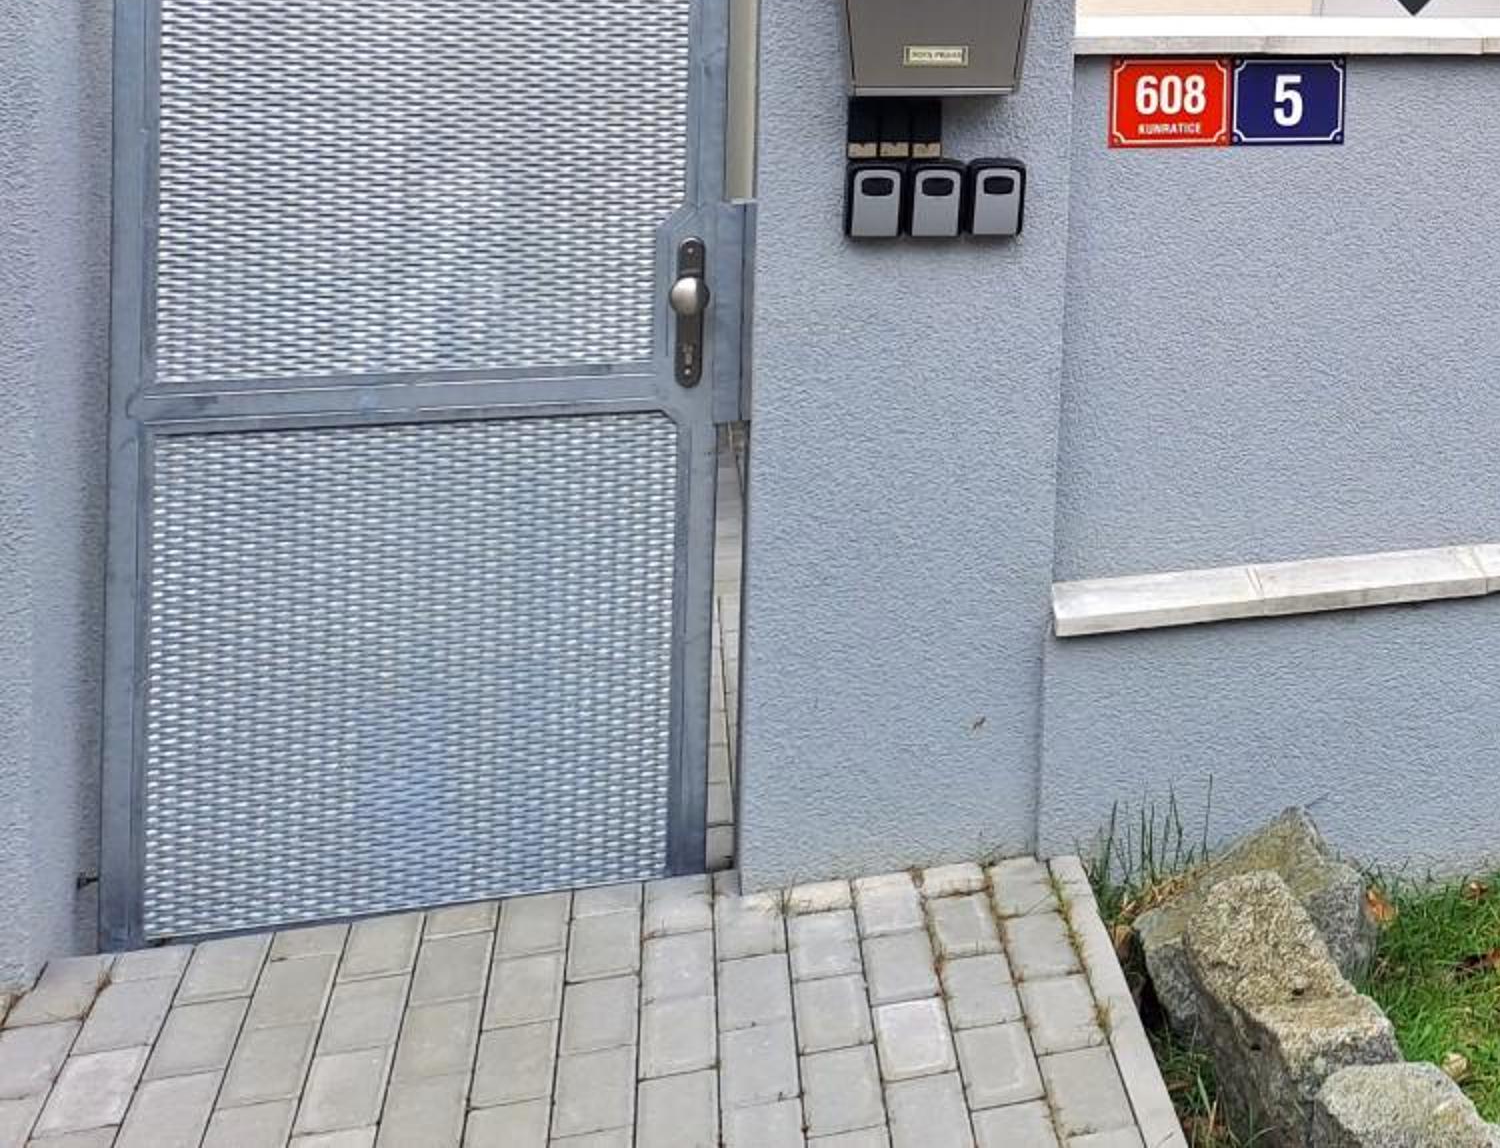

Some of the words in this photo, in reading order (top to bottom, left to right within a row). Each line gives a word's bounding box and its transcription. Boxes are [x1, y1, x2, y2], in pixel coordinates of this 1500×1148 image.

[1136, 75, 1206, 115] 608
[1274, 74, 1302, 127] 5
[1138, 123, 1202, 134] KUNRATICE
